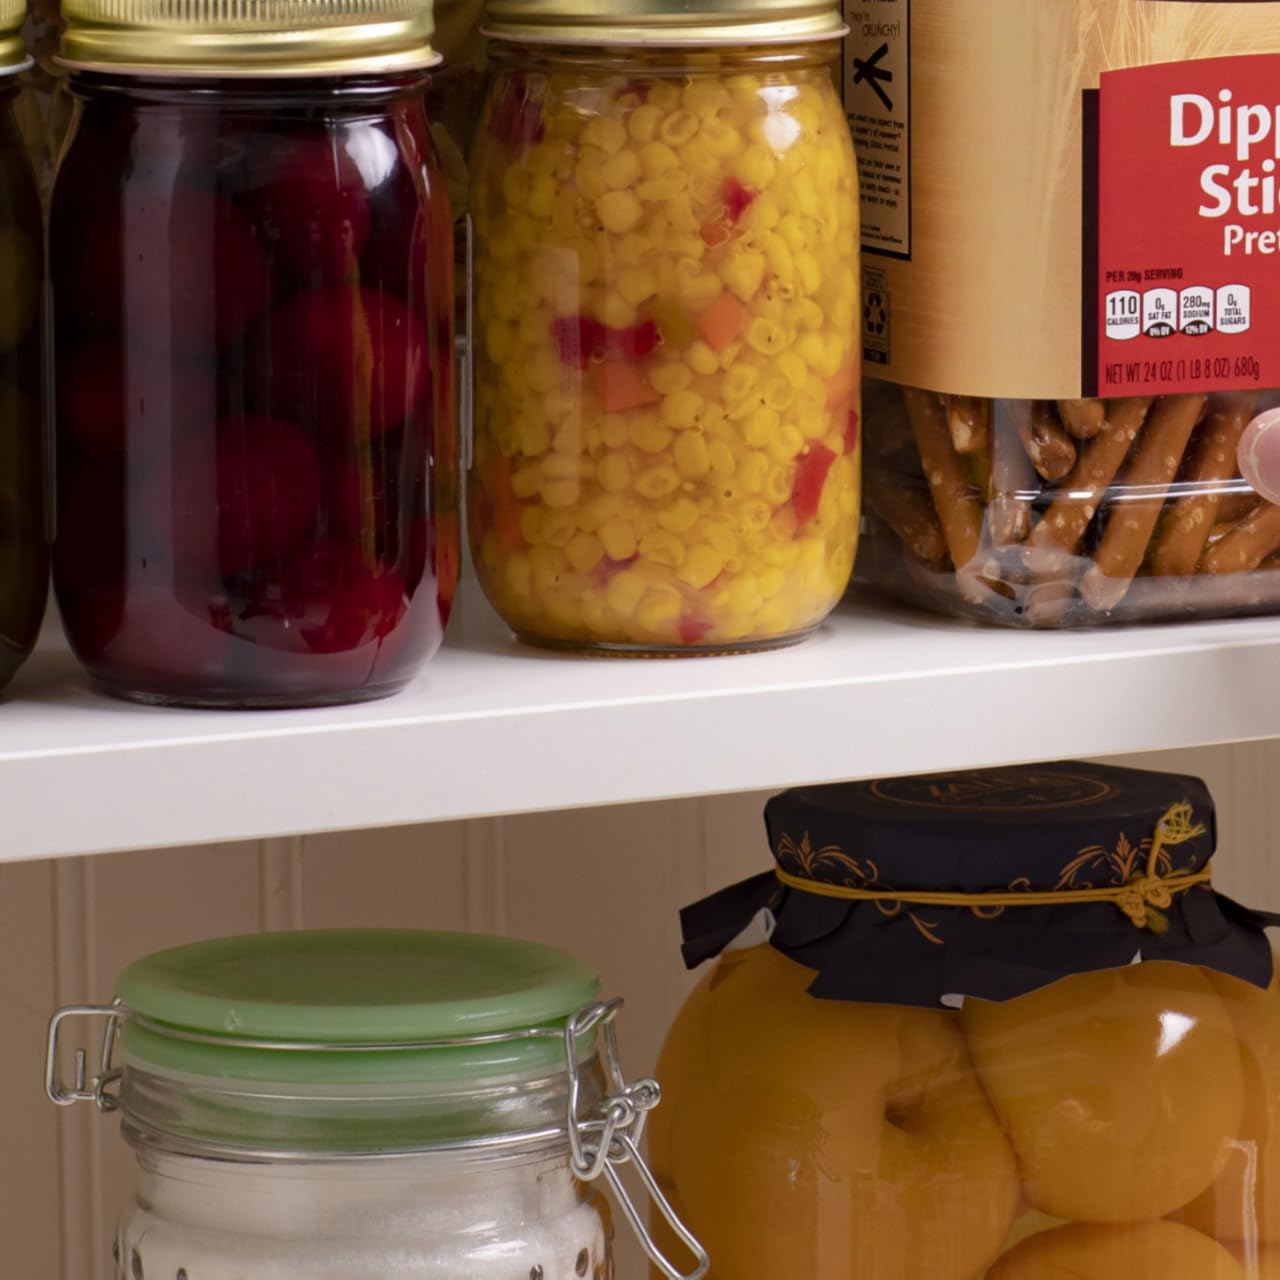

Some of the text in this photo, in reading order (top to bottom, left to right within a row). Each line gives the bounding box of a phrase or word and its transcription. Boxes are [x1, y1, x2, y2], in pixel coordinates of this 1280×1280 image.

[1106, 271, 1124, 283] PER
[1144, 268, 1183, 280] SERVING
[1109, 296, 1137, 315] 110
[1155, 297, 1165, 311] 0g
[1183, 296, 1210, 308] 280mg
[1227, 294, 1237, 307] 0g
[1148, 311, 1172, 320] SAT FAT
[1184, 310, 1210, 318] SODIUM
[1224, 308, 1242, 316] TOTAL
[1107, 317, 1139, 326] CALORIES
[1220, 317, 1246, 325] SUGARS
[1106, 356, 1260, 384] NET WT 24 OZ (1 LB 8 OZ) 680g
